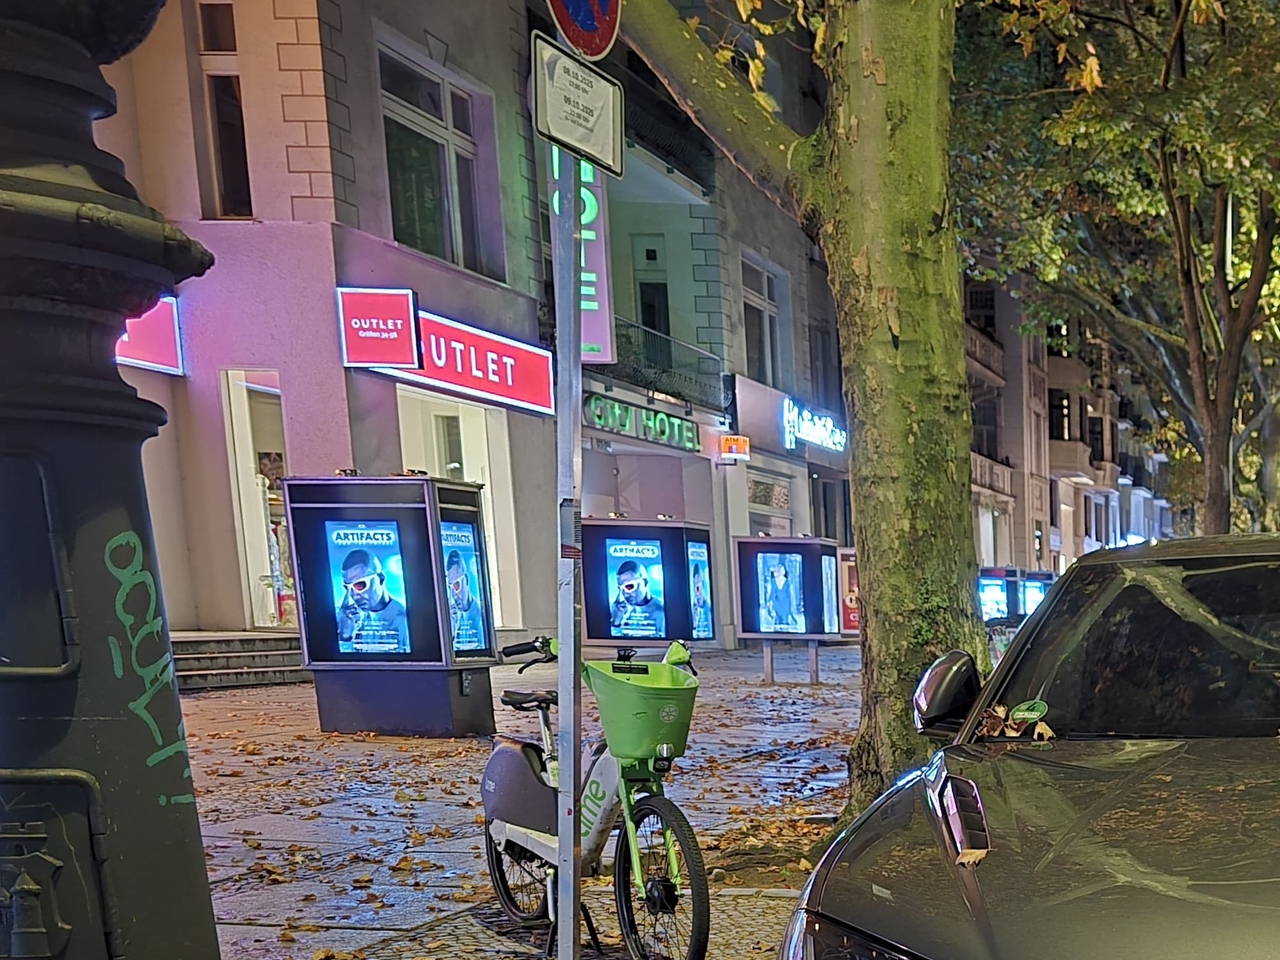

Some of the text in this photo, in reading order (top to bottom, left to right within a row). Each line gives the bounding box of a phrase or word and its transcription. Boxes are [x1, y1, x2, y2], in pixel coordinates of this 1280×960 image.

[351, 318, 403, 330] OUTLET
[421, 333, 515, 386] UTLET
[642, 408, 703, 451] HOTEL
[335, 532, 392, 541] ARTIFACTS
